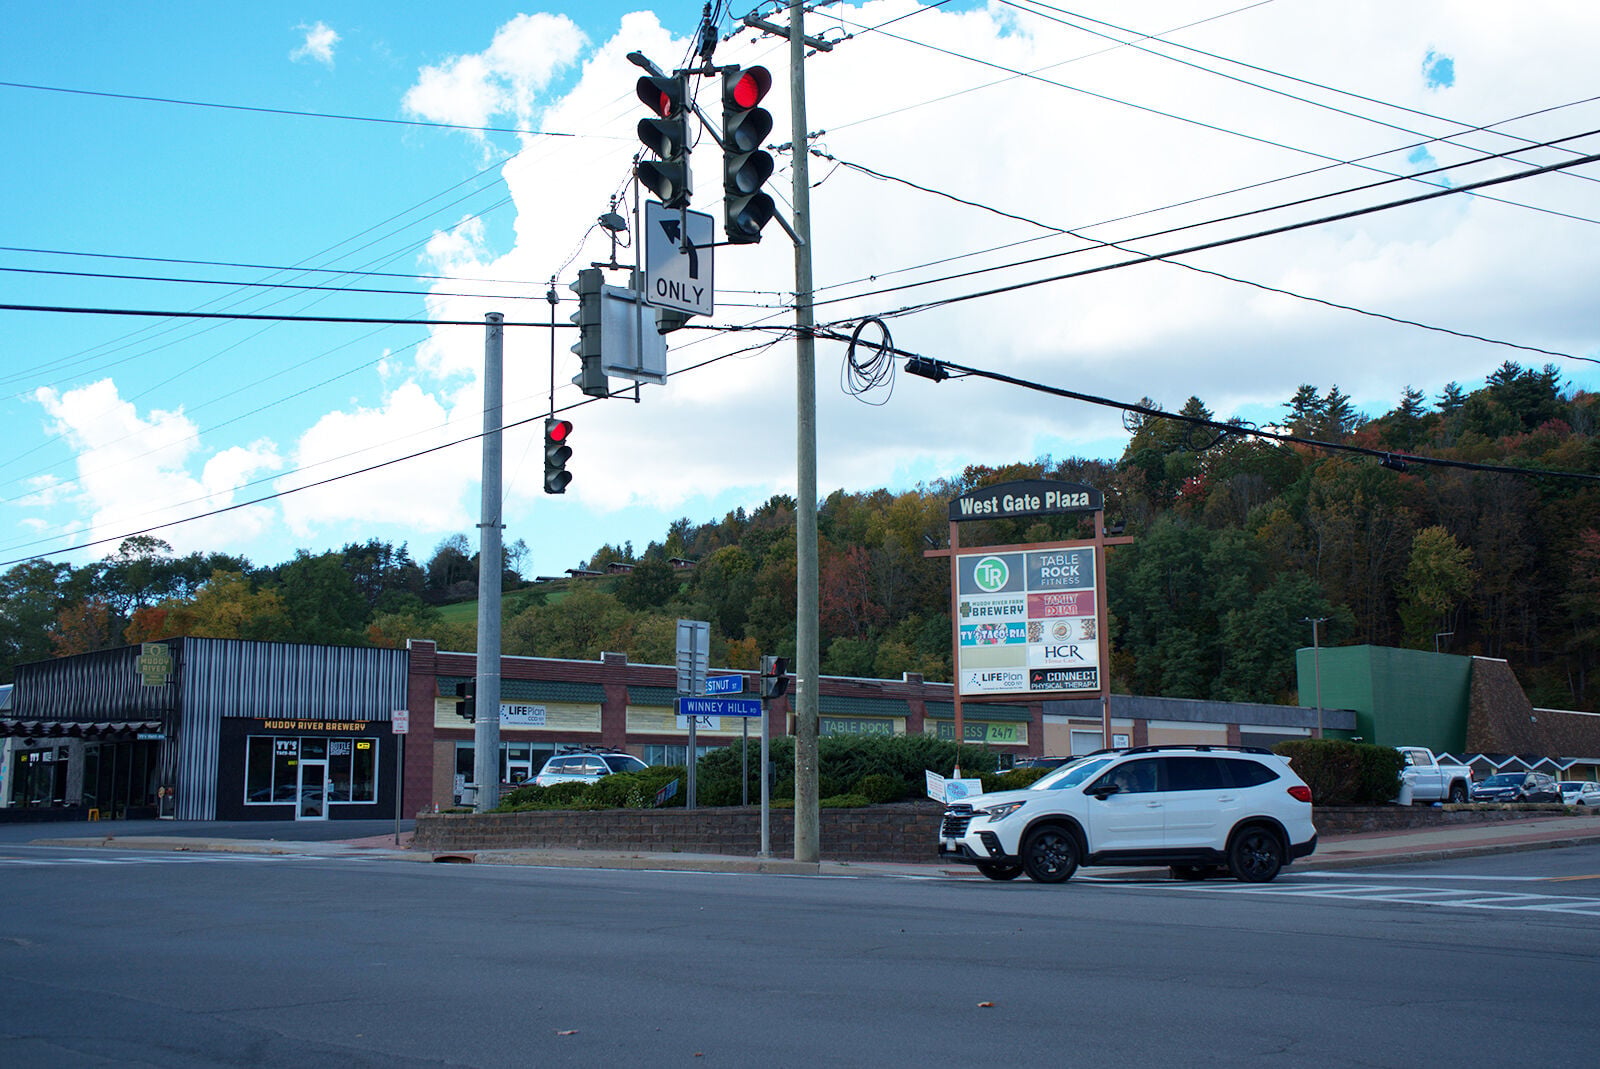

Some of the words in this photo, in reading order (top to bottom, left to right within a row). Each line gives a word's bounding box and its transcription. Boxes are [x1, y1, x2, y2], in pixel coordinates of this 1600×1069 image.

[657, 278, 704, 305] ONLY
[960, 496, 998, 515] West
[1002, 493, 1041, 512] Gate
[1045, 490, 1089, 509] Plaza
[1040, 554, 1079, 567] TABLE
[977, 564, 1002, 588] TR
[1041, 565, 1080, 578] ROCK
[1041, 576, 1080, 586] FITNESS
[1044, 594, 1078, 605] FAMILY
[972, 605, 1024, 617] BREWERY
[1045, 605, 1078, 616] DOLLAR
[1045, 645, 1084, 660] HCR
[140, 657, 169, 665] MUDDY
[142, 664, 167, 673] RIVER
[982, 672, 1023, 682] LIFEPlan
[1047, 671, 1096, 682] CONNECT
[1064, 680, 1096, 688] THERAPY
[509, 705, 545, 716] LIFEPlan
[687, 701, 723, 713] WINNEY
[727, 703, 748, 713] HILL
[264, 720, 297, 730] MUDDY
[297, 721, 324, 731] RIVER
[325, 722, 366, 731] BREWERY
[823, 720, 857, 733] TABLE
[860, 723, 890, 735] ROCK
[941, 725, 983, 737] FITESS
[991, 727, 1013, 739] 24/7
